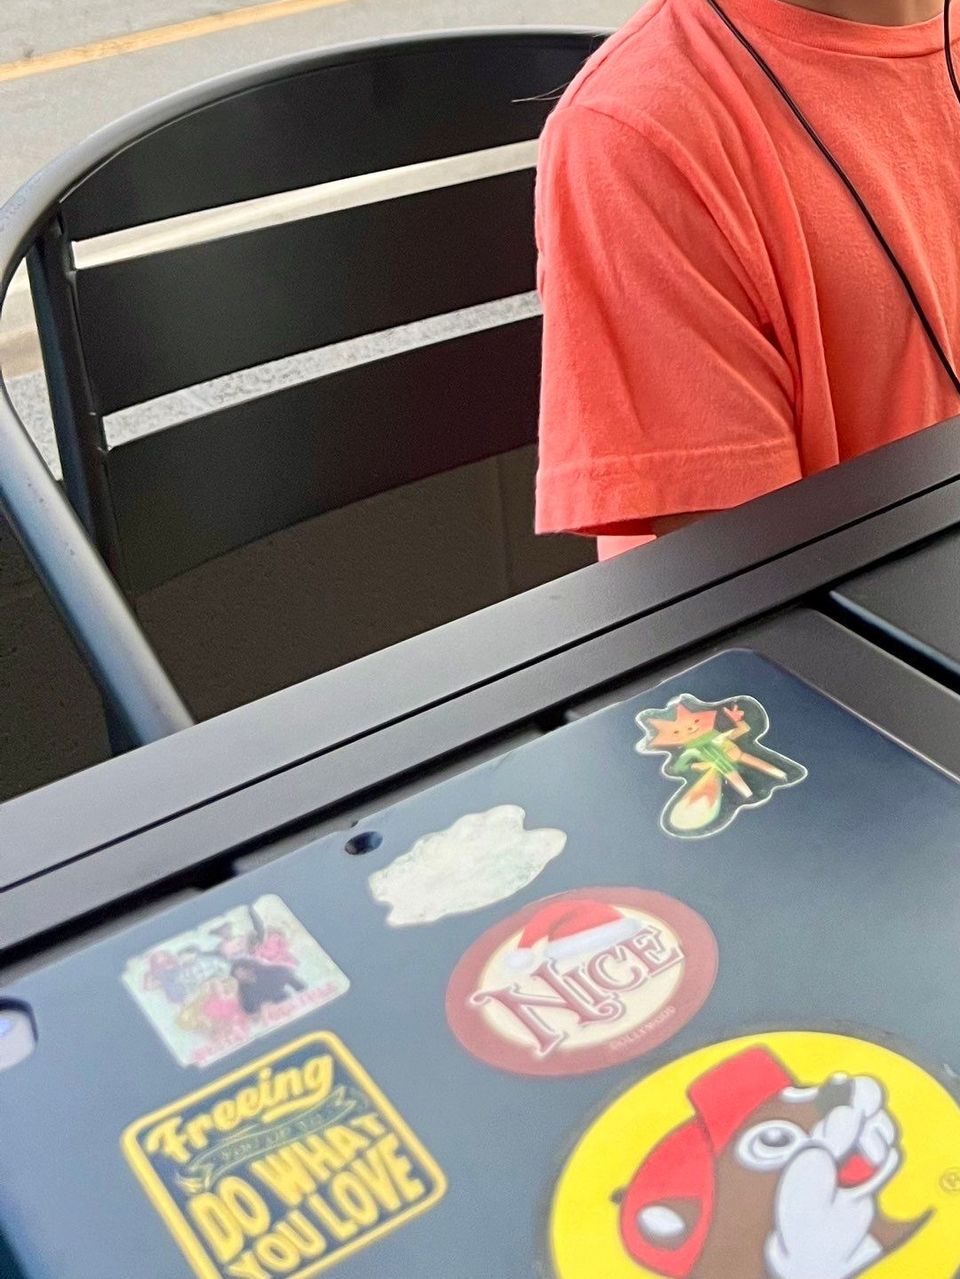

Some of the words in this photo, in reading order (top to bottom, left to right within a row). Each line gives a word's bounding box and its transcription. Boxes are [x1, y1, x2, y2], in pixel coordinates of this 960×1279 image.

[469, 925, 686, 1058] NICE
[145, 1054, 334, 1164] Freeing
[187, 1175, 271, 1265] DO
[250, 1111, 386, 1208] WHAT
[226, 1209, 327, 1279] YOU
[305, 1131, 426, 1242] LOVE
